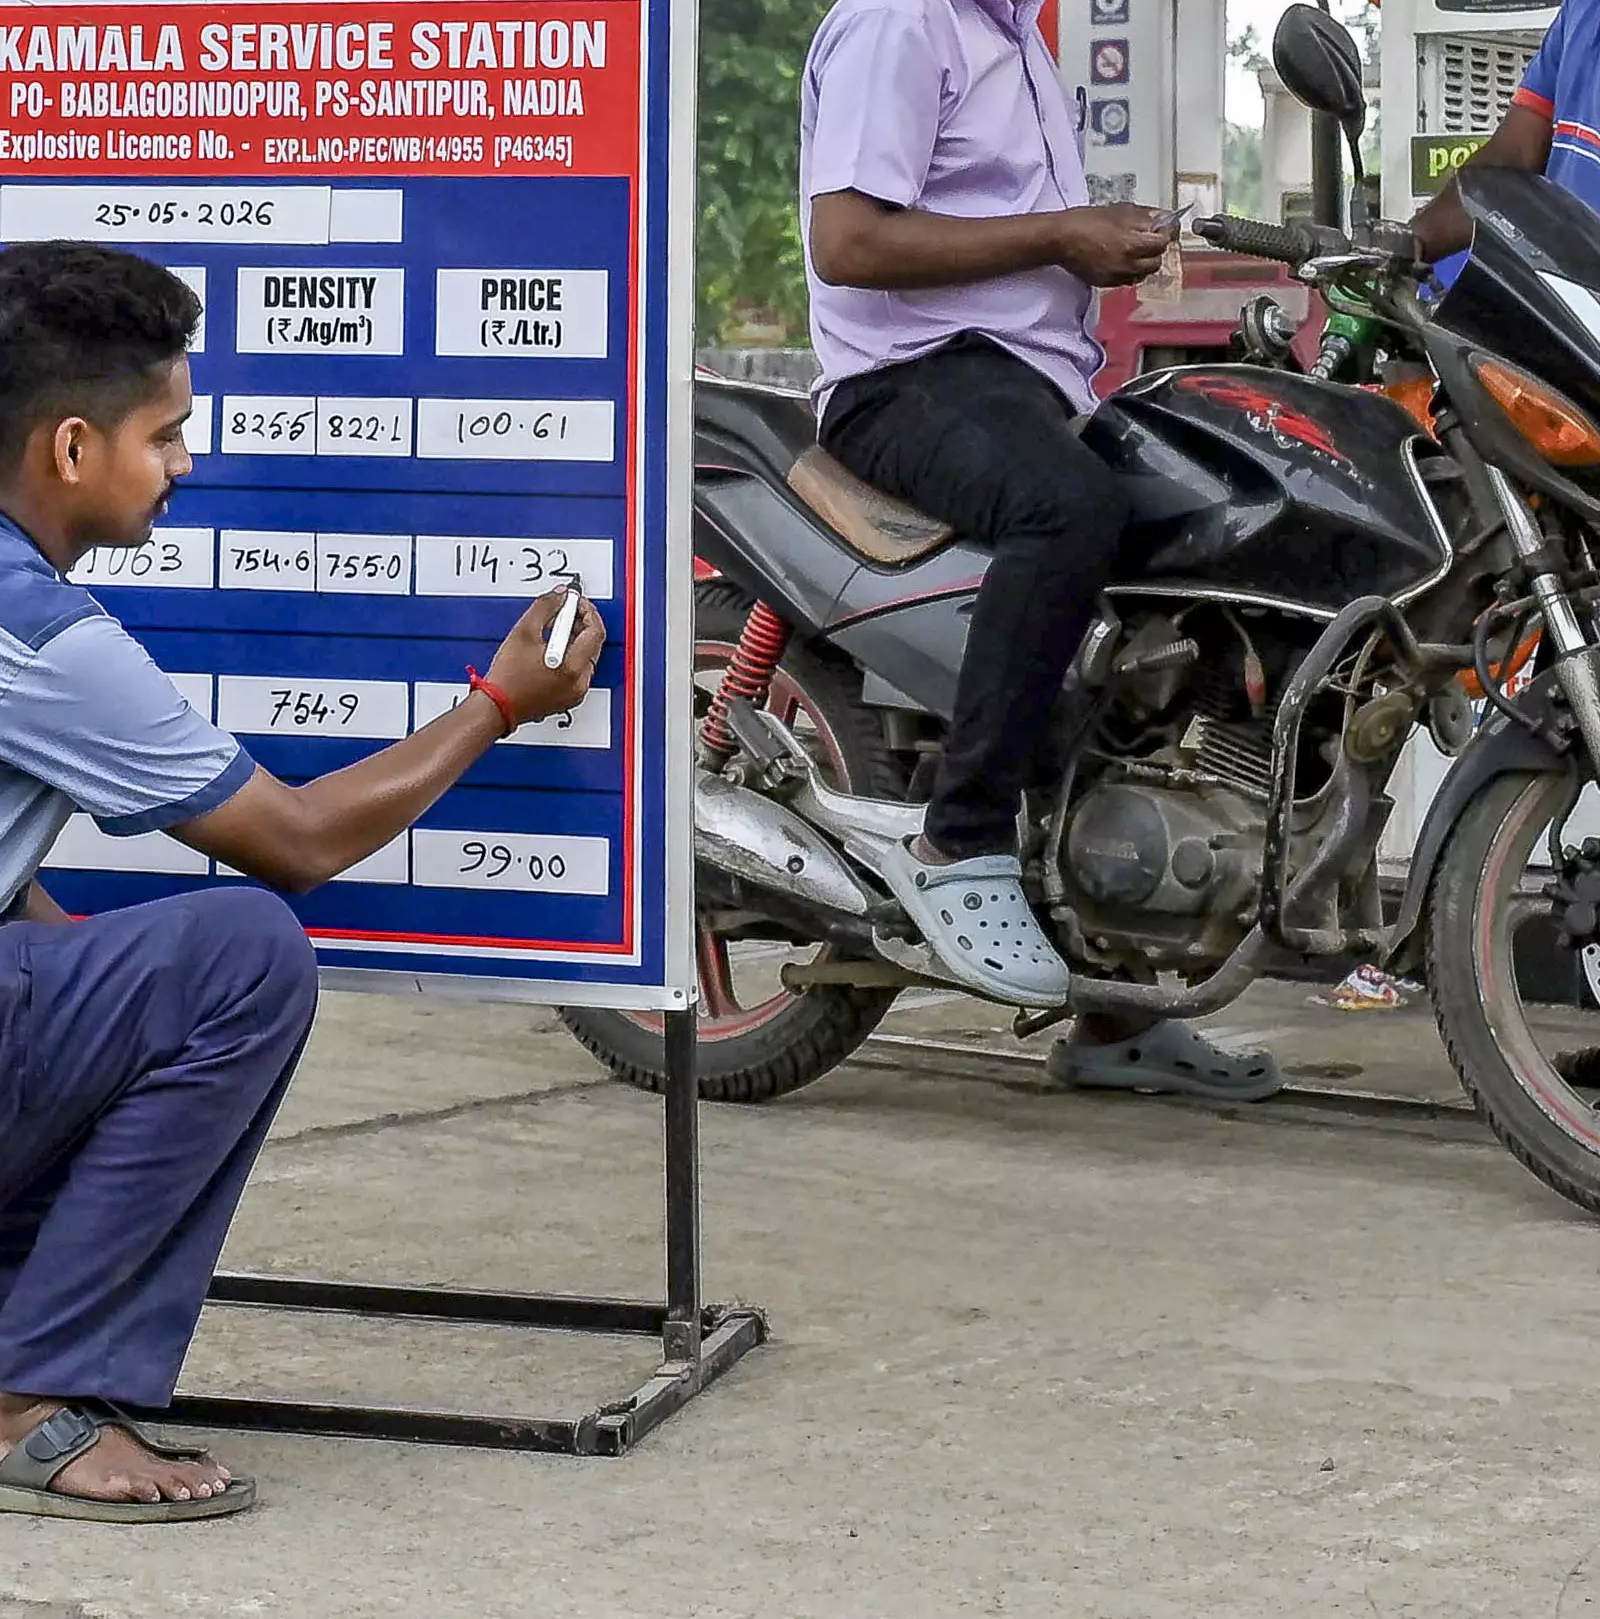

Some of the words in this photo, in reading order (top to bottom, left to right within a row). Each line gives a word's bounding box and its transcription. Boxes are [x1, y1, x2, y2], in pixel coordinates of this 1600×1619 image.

[200, 23, 394, 71] SERVICE
[410, 20, 607, 69] STATION
[10, 81, 53, 118] PO-
[60, 80, 308, 121] BABLAGOBINDOPUR,
[315, 79, 496, 120] PS-SANTIPUR,
[503, 79, 585, 117] NADIA
[106, 130, 193, 160] Licence
[198, 130, 235, 160] No.
[494, 135, 573, 168] [P46345]
[1428, 141, 1479, 177] po
[263, 275, 377, 310] DENSITY
[481, 278, 563, 312] PRICE
[459, 841, 566, 881] 99.00
